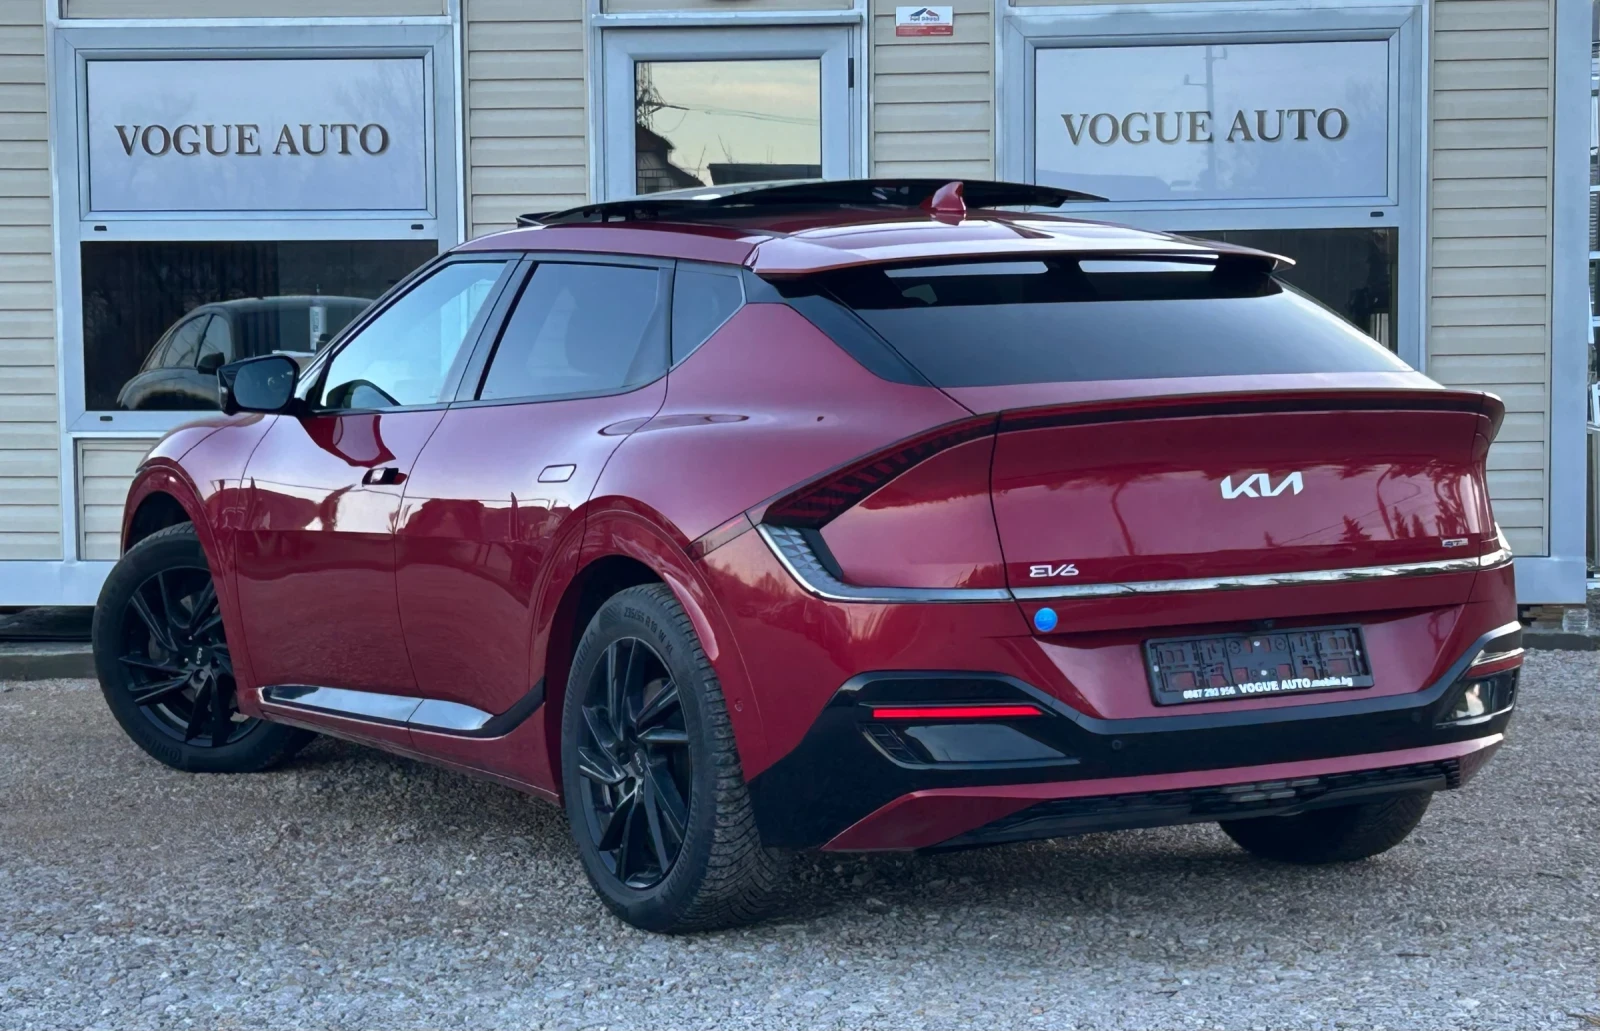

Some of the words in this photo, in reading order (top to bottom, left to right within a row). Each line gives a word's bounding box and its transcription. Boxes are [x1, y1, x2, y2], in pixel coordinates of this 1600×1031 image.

[114, 124, 261, 156] VOGUE
[272, 123, 390, 155] AUTO
[1061, 111, 1213, 145] VOGUE
[1226, 108, 1348, 143] AUTO
[1220, 471, 1304, 499] KIA
[1029, 564, 1080, 578] EV6
[1238, 680, 1280, 694] VOGUE
